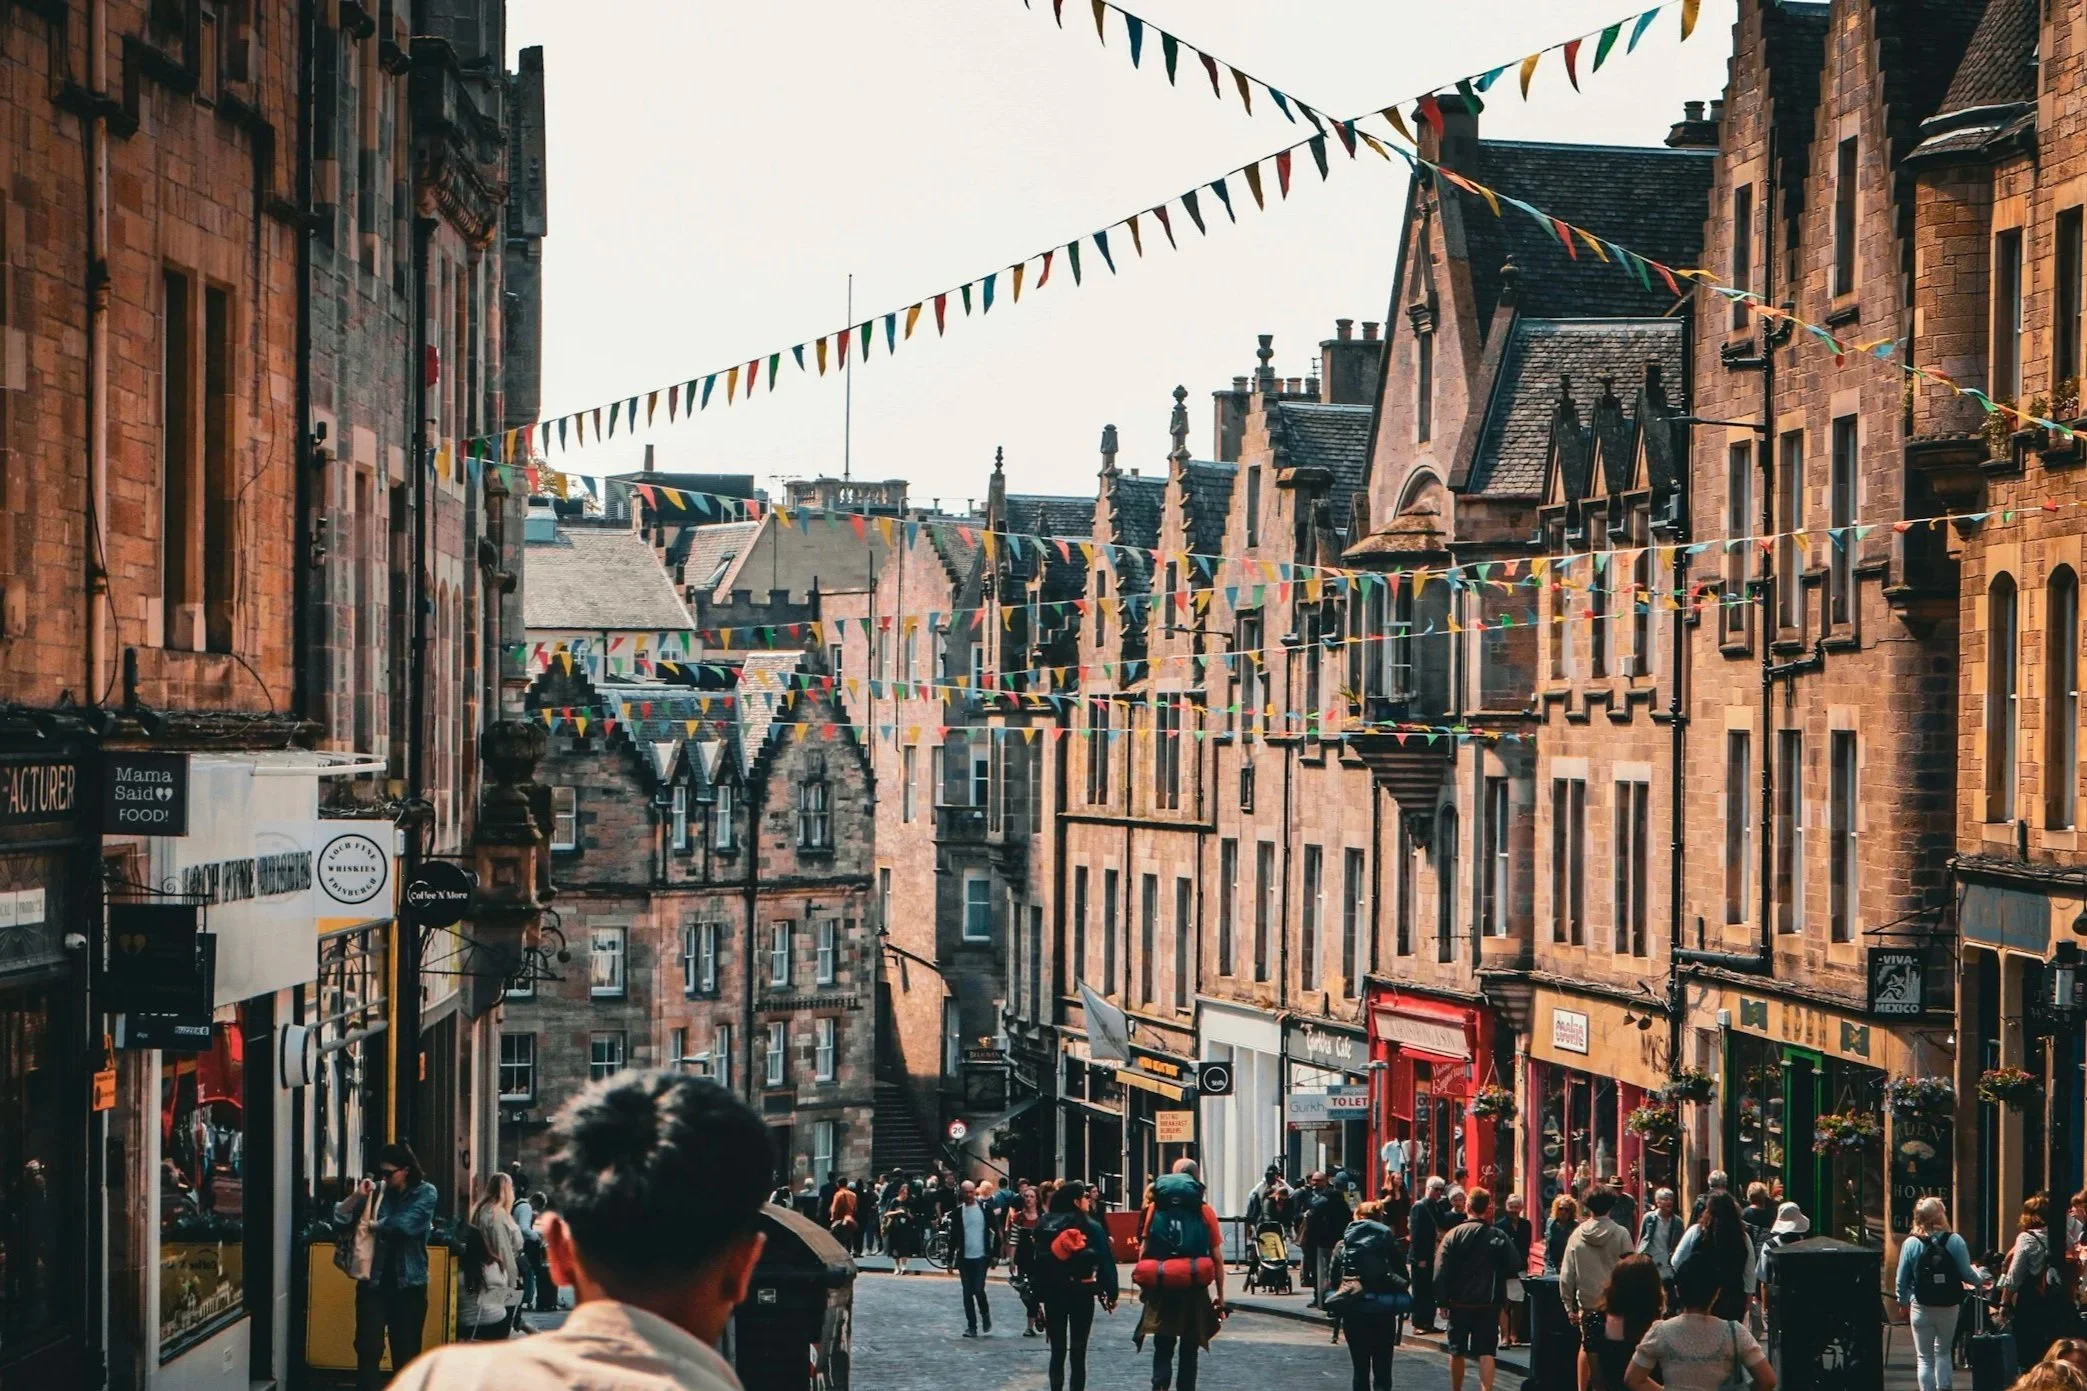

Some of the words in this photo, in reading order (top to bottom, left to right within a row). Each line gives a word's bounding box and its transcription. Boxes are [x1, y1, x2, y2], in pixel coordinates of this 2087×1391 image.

[115, 767, 173, 783] Mama
[115, 785, 153, 801] Said
[119, 808, 169, 822] FOOD!
[329, 842, 351, 860] LOCH
[355, 842, 376, 860] FYNE
[328, 865, 376, 873] WHISKIES
[328, 877, 377, 896] EDINBURGH
[410, 891, 436, 900] Coffee
[447, 891, 468, 899] More
[1883, 955, 1913, 965] VIVA
[1875, 1003, 1920, 1014] MEXICO
[1289, 1098, 1328, 1113] Gurkh
[1332, 1097, 1347, 1107] TO
[1349, 1097, 1368, 1107] LET
[952, 1126, 964, 1134] 20
